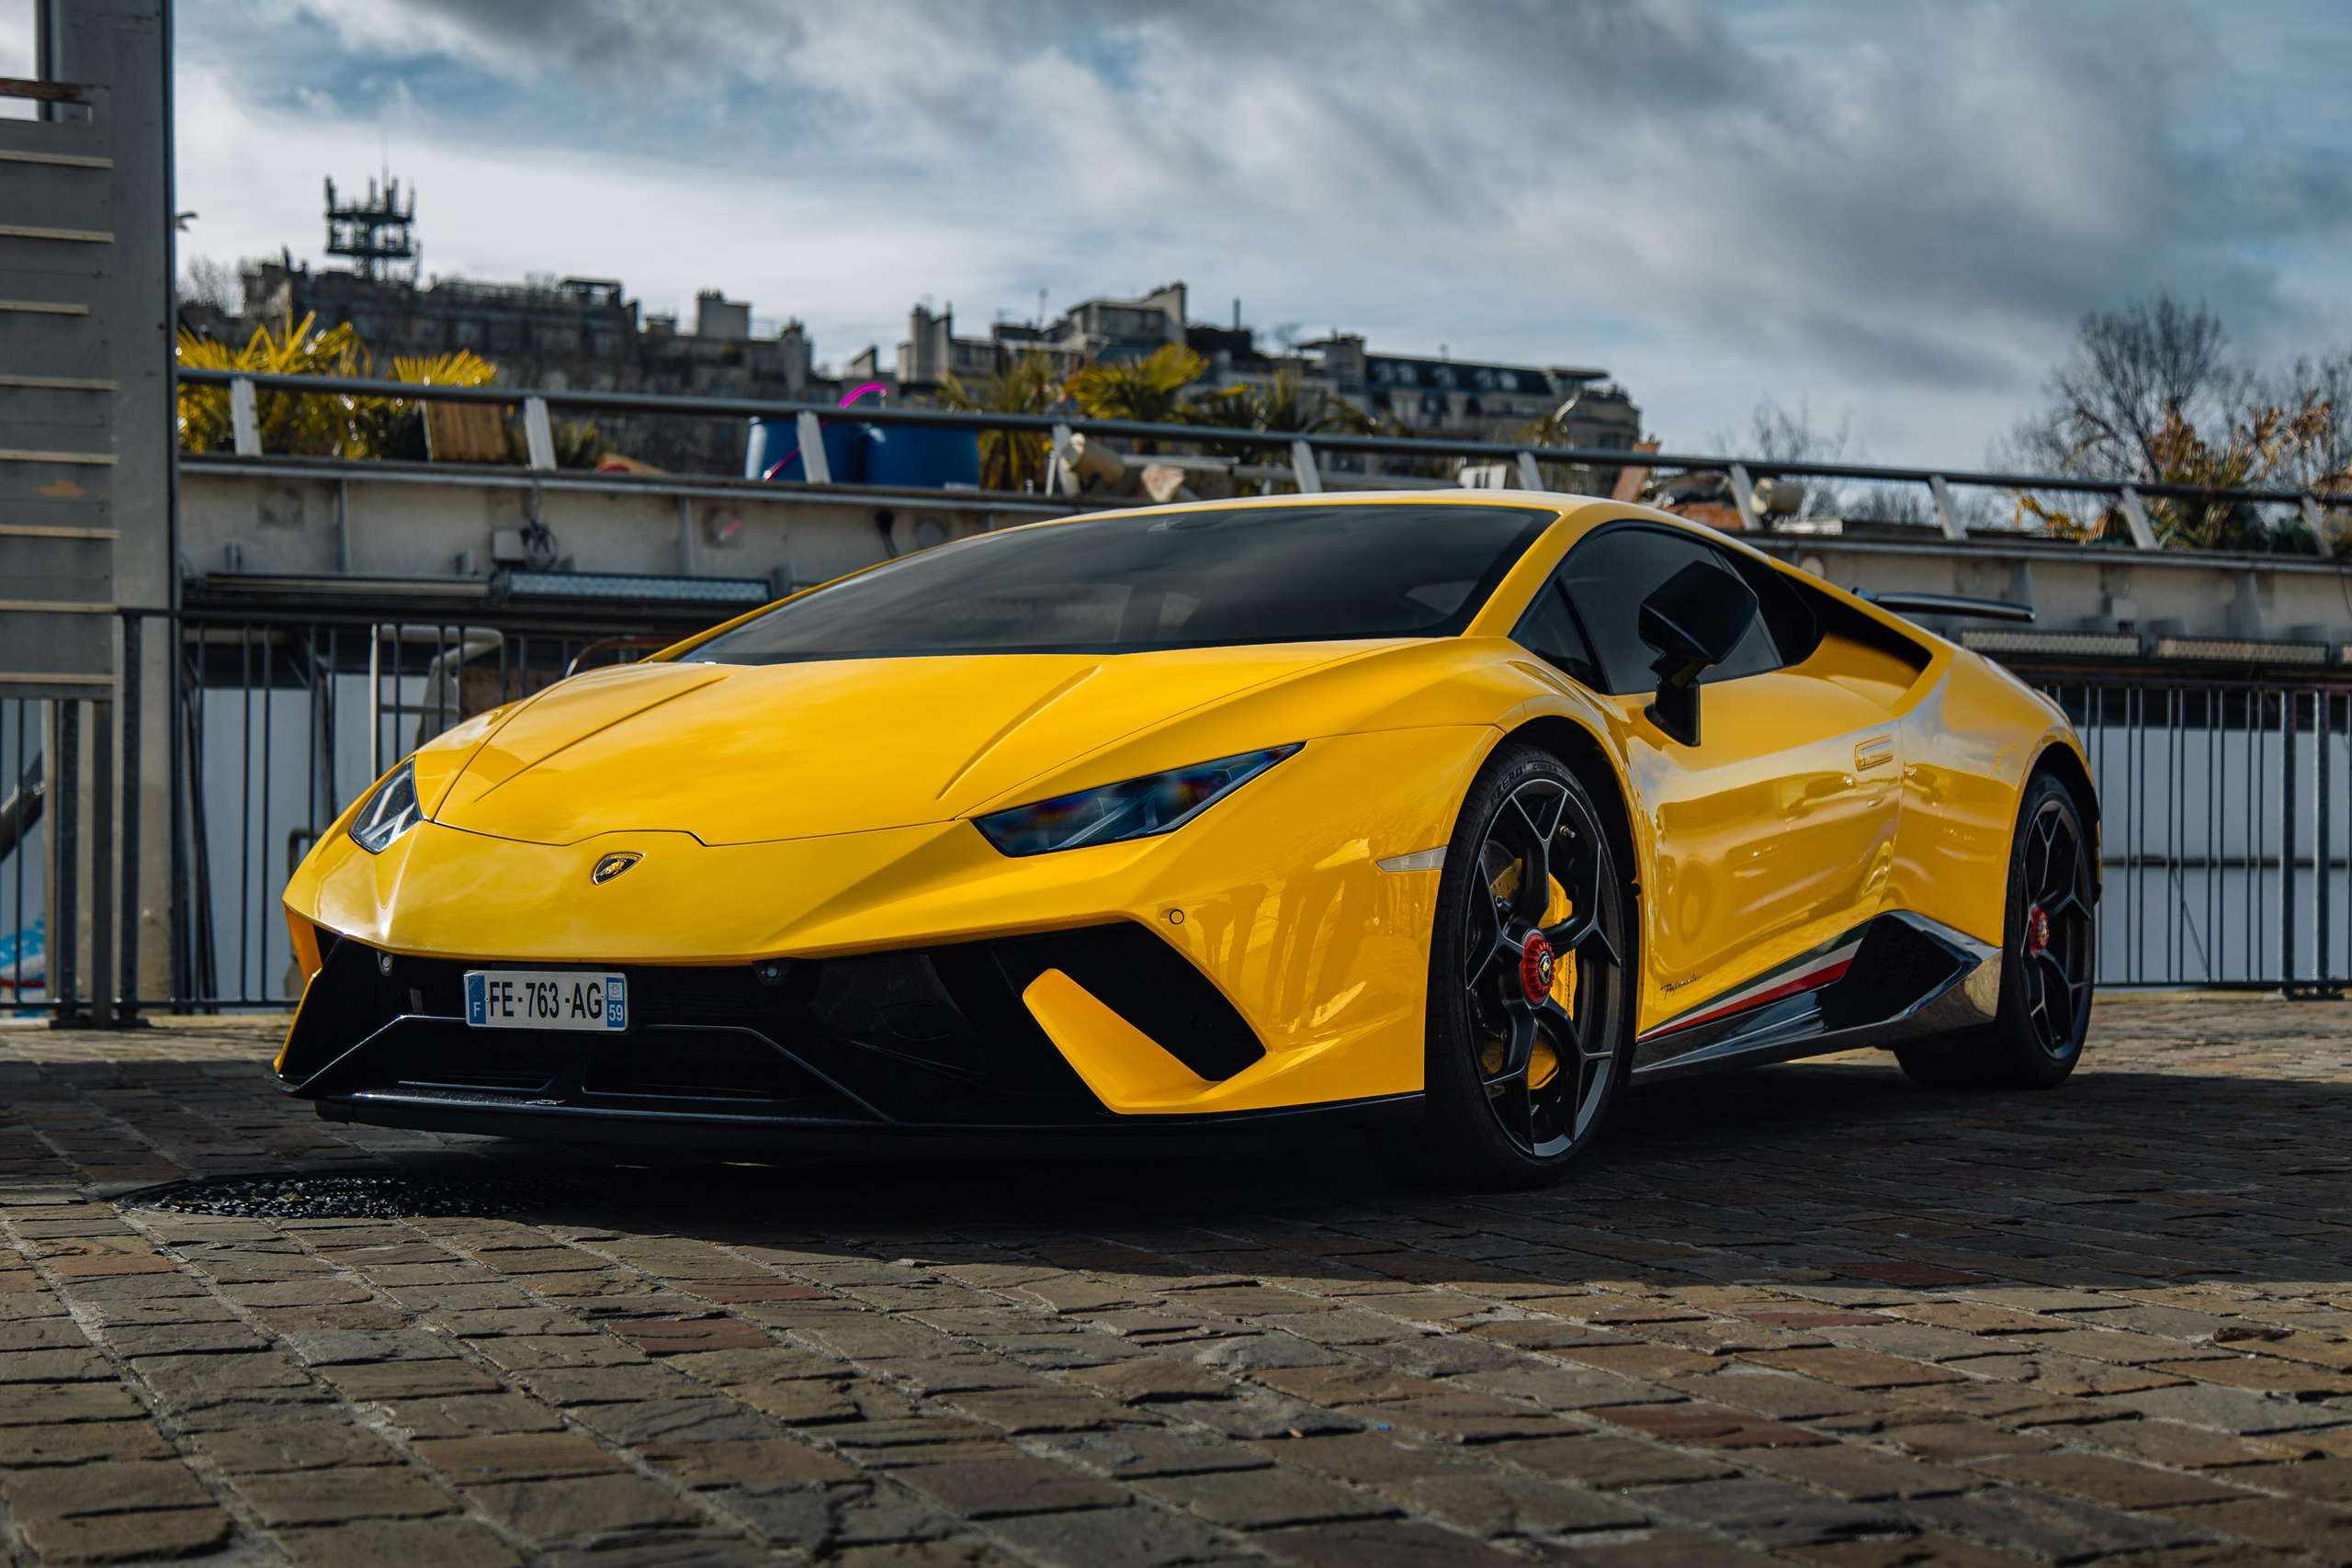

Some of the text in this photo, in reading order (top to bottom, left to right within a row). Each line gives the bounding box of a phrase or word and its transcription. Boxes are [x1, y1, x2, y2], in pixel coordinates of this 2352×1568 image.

[1532, 762, 1559, 773] CORSA
[490, 981, 603, 1020] FE-763-AG
[473, 1001, 481, 1017] F
[608, 1004, 624, 1021] 59
